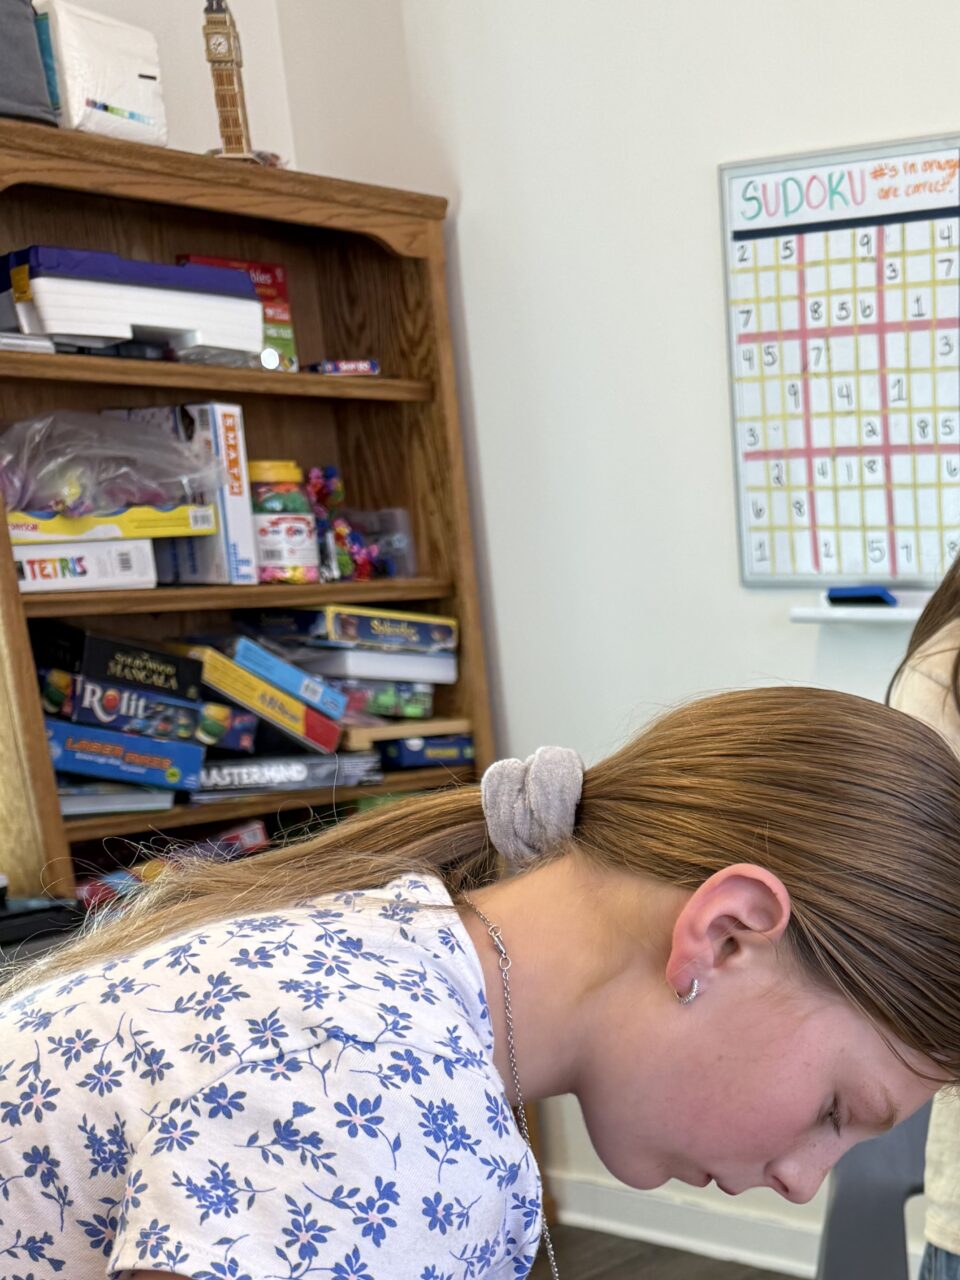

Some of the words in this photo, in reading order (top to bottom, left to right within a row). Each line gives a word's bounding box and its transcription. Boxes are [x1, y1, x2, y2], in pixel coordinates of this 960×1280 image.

[741, 168, 867, 221] SUDOKU
[737, 245, 749, 263] 2
[780, 239, 795, 260] 5
[859, 233, 873, 255] 9
[939, 225, 954, 249] 4
[885, 262, 899, 280] 3
[937, 258, 955, 277] 7
[738, 309, 753, 329] 7
[810, 301, 824, 322] 8
[836, 302, 851, 321] 5
[912, 295, 927, 318] 1
[742, 350, 755, 371] 4
[763, 345, 778, 367] 5
[810, 346, 824, 367] 7
[939, 335, 954, 357] 3
[787, 383, 800, 409] 9
[837, 383, 852, 406] 4
[891, 378, 907, 403] 1
[746, 427, 760, 447] 3
[917, 419, 930, 440] 8
[941, 418, 955, 437] 5
[751, 500, 766, 520] 6
[792, 499, 807, 518] 8
[754, 539, 769, 564] 1
[868, 539, 886, 564] 5
[26, 556, 88, 580] TETRIS
